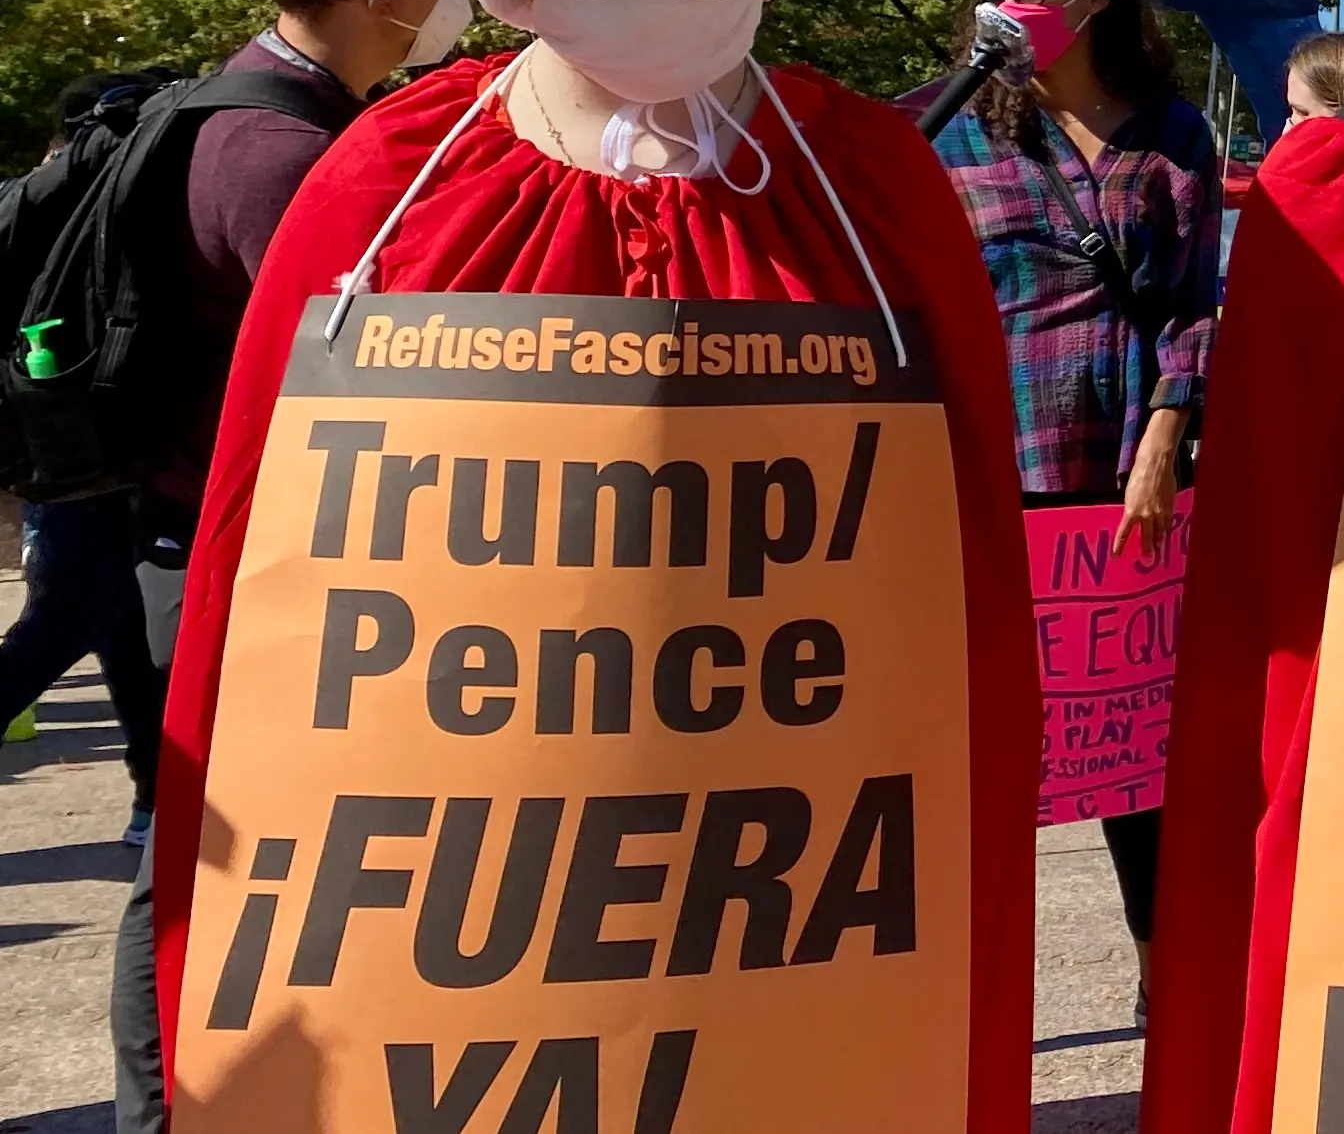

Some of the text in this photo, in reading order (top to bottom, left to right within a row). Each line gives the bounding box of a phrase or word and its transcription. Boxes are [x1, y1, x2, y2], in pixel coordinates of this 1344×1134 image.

[354, 312, 877, 386] RefuseFascism.org
[307, 419, 882, 599] Trump/
[311, 587, 846, 737] Pence
[1063, 700, 1096, 723] IN
[1065, 716, 1134, 750] PLAY
[205, 772, 918, 1031] ¡FUERA
